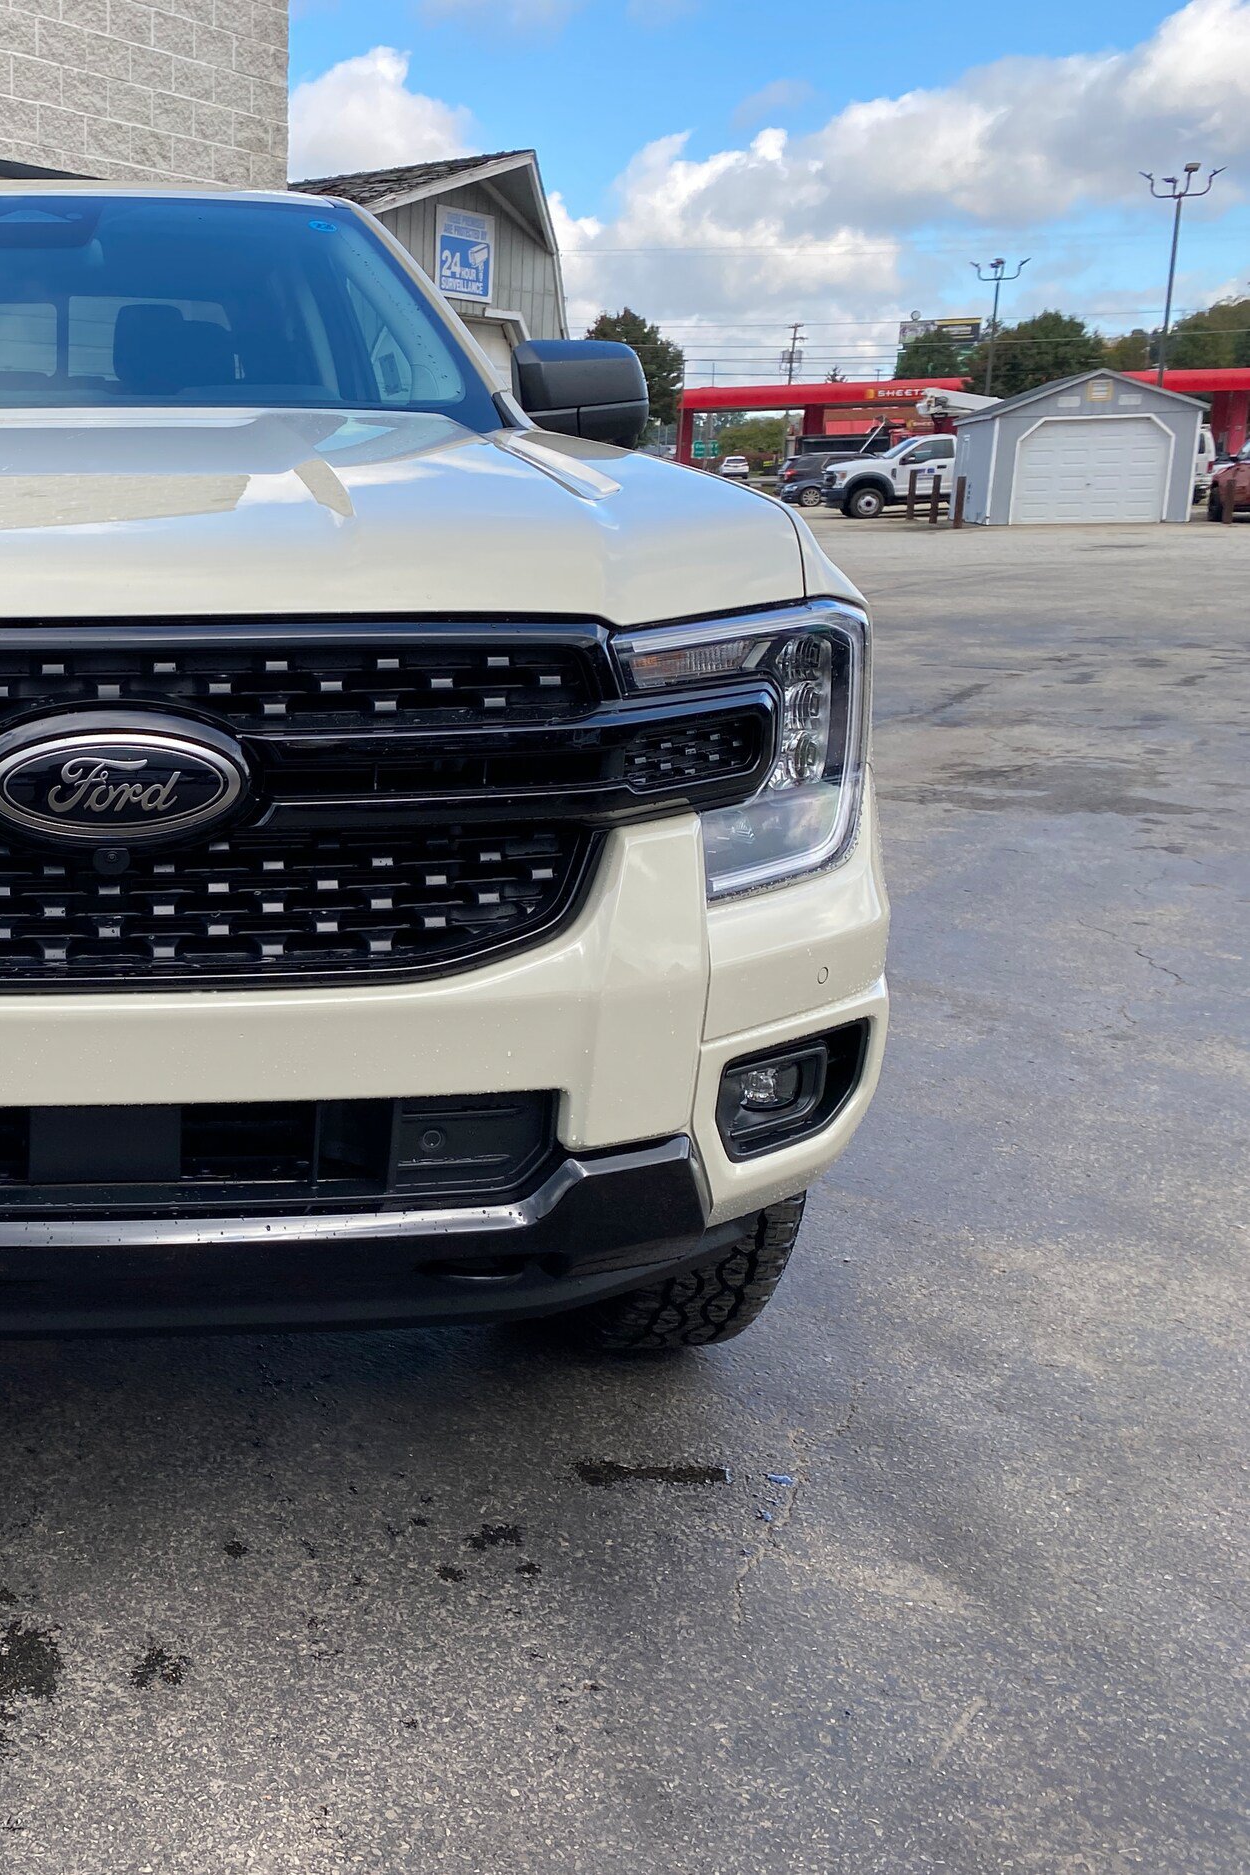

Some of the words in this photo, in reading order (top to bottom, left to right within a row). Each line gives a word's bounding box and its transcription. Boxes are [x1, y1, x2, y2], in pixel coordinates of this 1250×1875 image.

[442, 249, 461, 278] 24
[461, 267, 477, 281] HOUR
[441, 277, 483, 294] SURVEILLANCE
[48, 756, 182, 813] Ford
